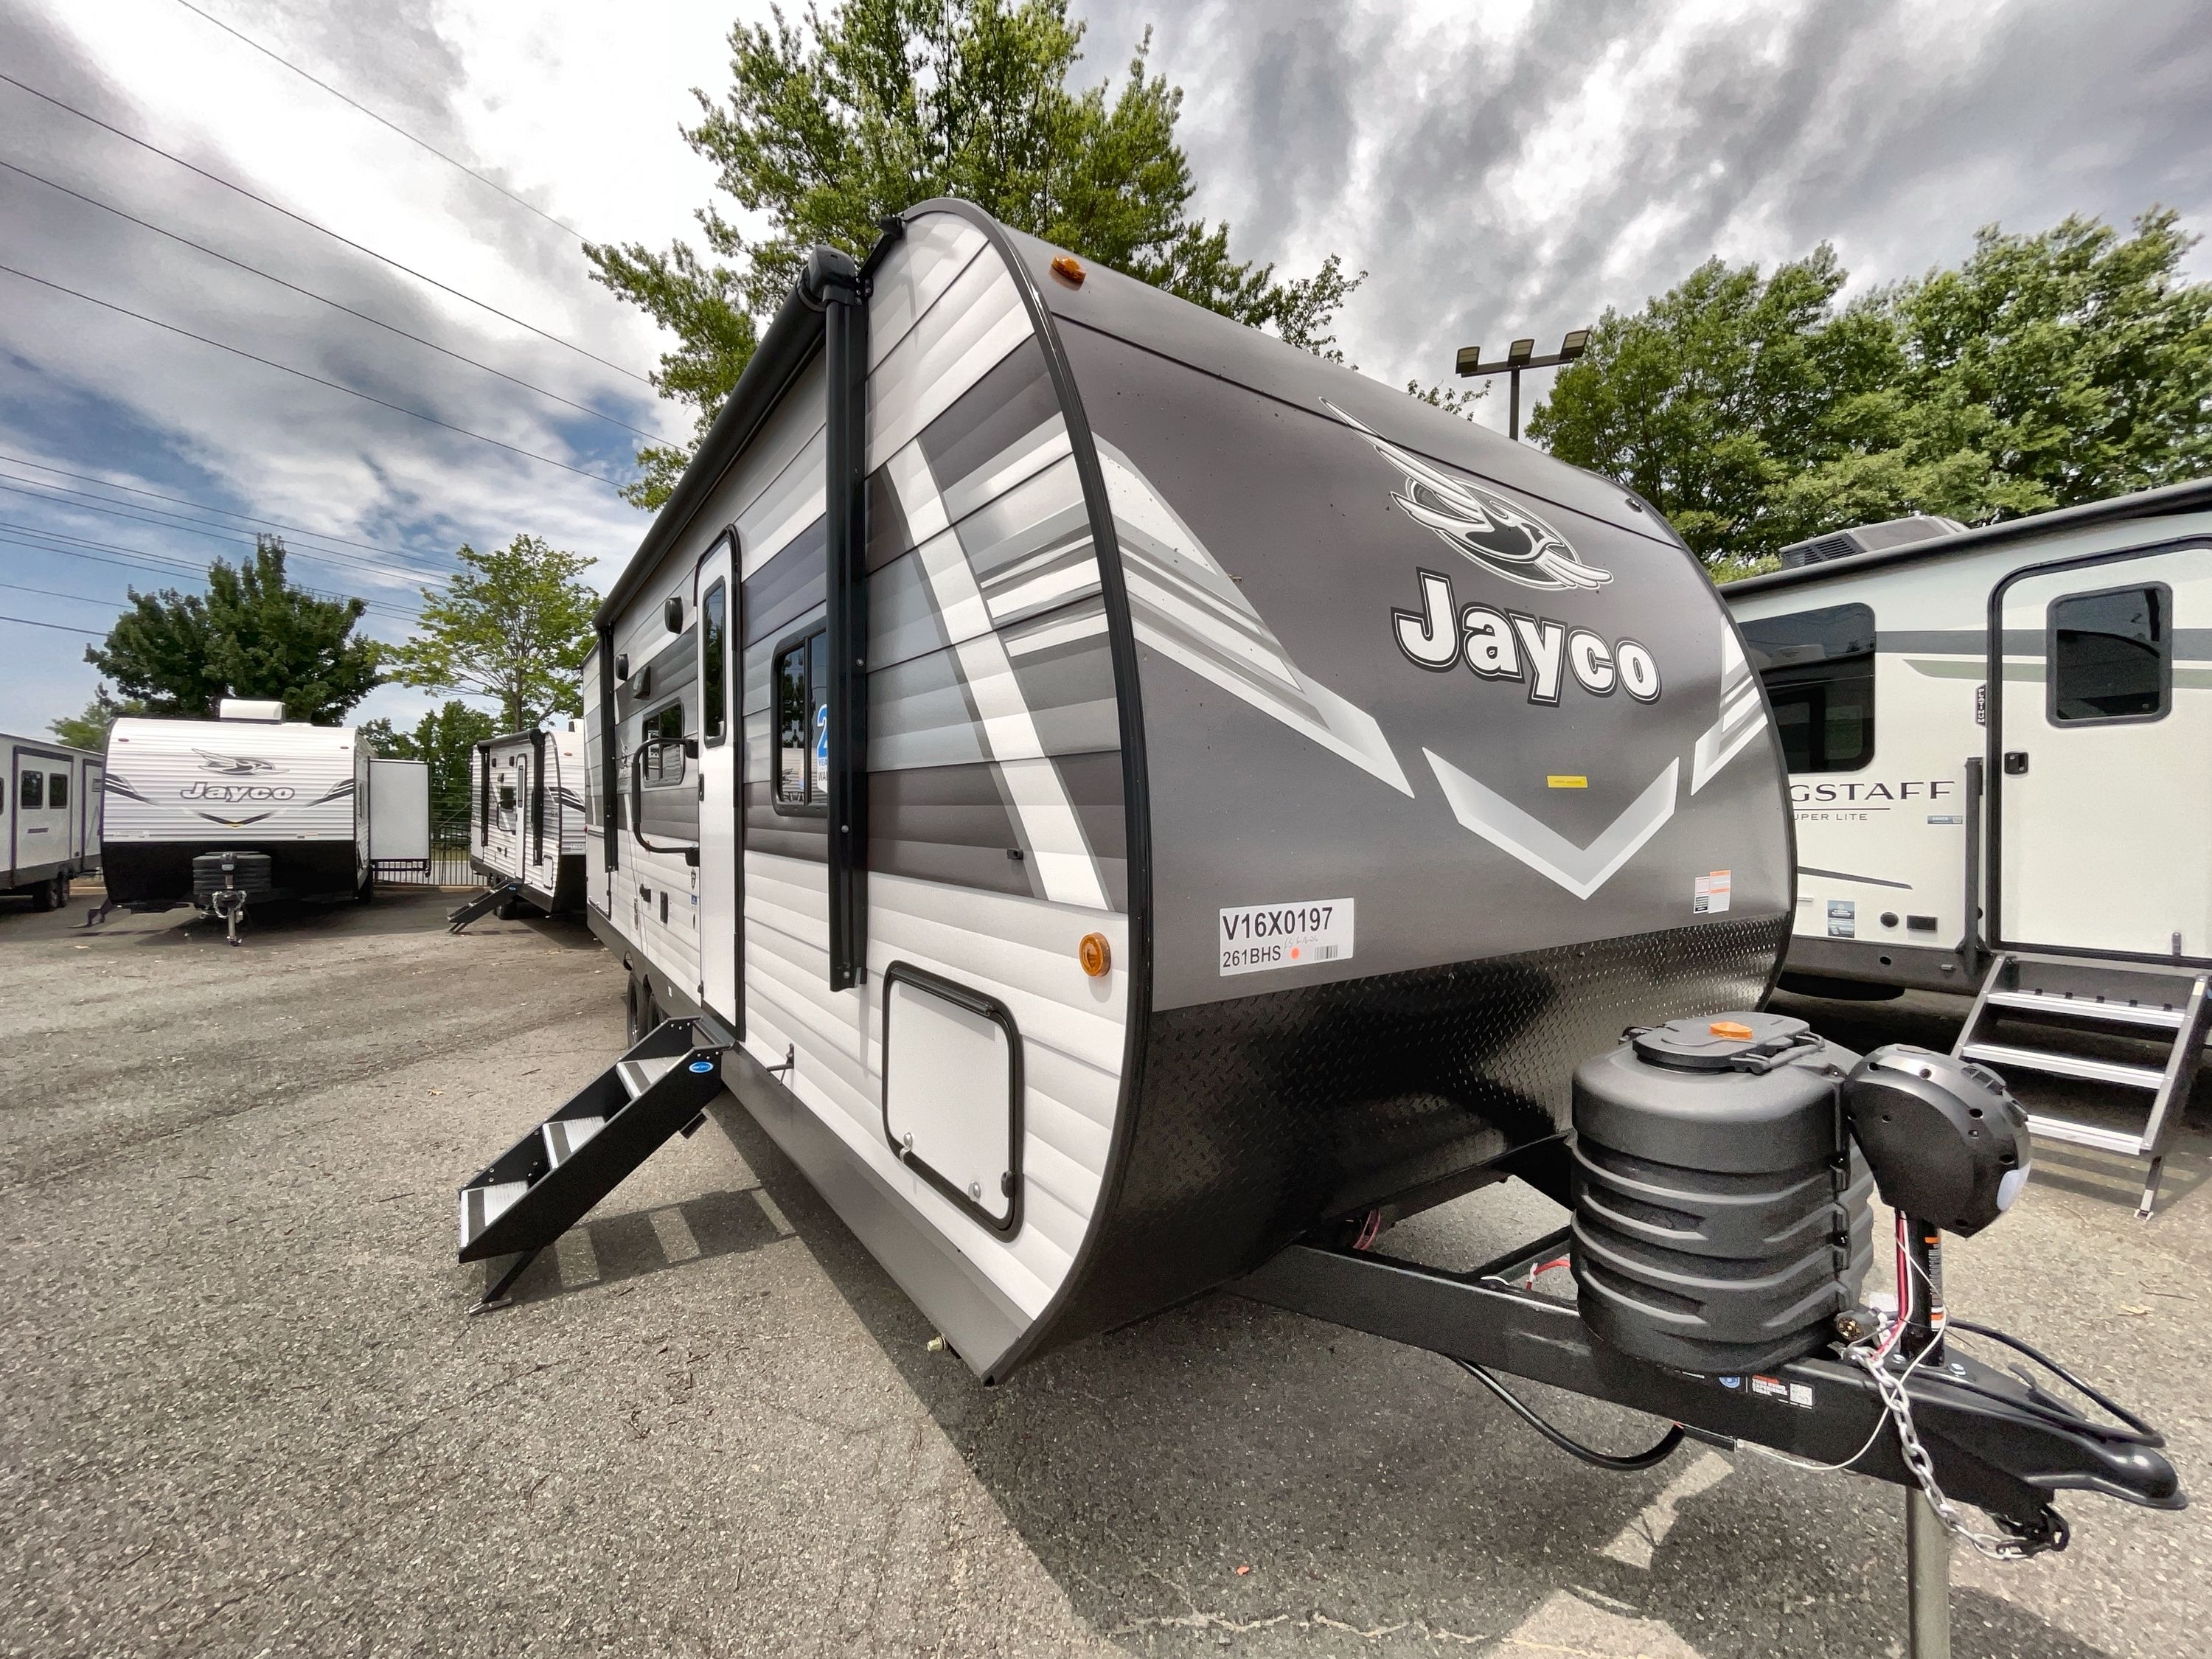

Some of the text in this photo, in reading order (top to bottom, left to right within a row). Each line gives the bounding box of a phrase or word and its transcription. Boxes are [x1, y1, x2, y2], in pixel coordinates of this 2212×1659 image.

[1391, 566, 1662, 708] Jayco
[180, 782, 295, 802] Jayco
[1789, 782, 1955, 801] GSTAFF
[1222, 907, 1332, 941] V16X0197
[1222, 945, 1281, 967] 261BHS
